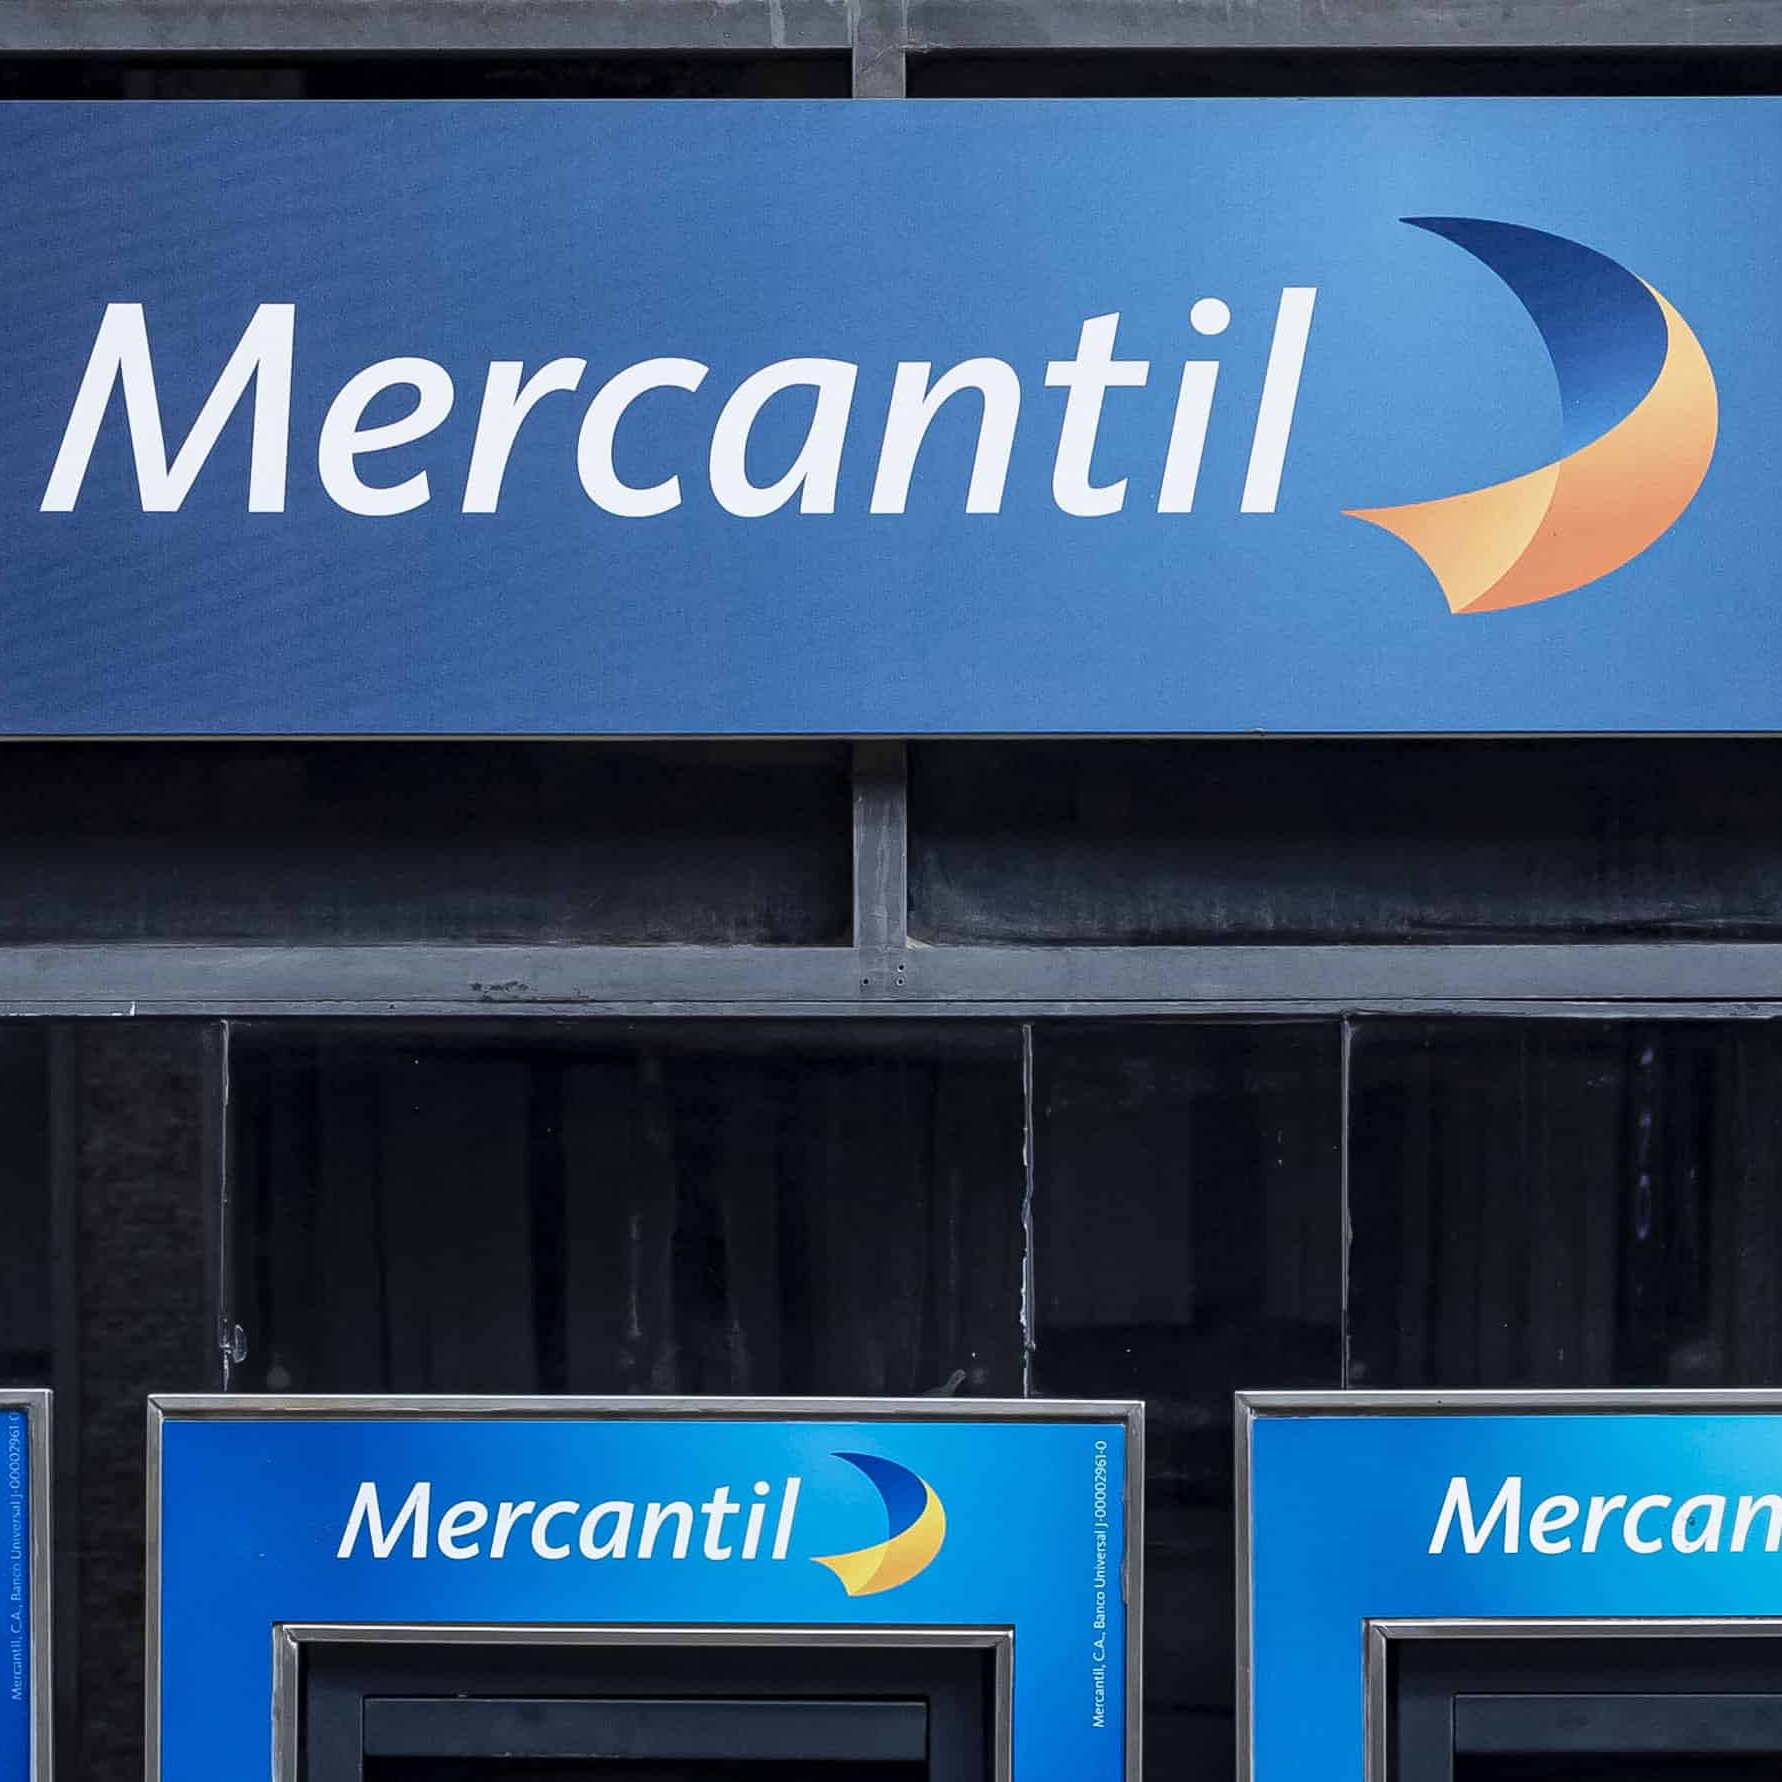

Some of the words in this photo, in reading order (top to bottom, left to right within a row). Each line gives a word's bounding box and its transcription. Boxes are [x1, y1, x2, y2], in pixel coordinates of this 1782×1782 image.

[40, 286, 1317, 518] Mercantil
[1094, 1440, 1110, 1528] J-00002961-0
[10, 1500, 21, 1560] Universal
[337, 1477, 801, 1561] Mercantil
[10, 1563, 22, 1601] Banco
[1093, 1530, 1107, 1589] Universal
[1093, 1591, 1106, 1629] Banco
[1092, 1664, 1107, 1728] Mercantil,
